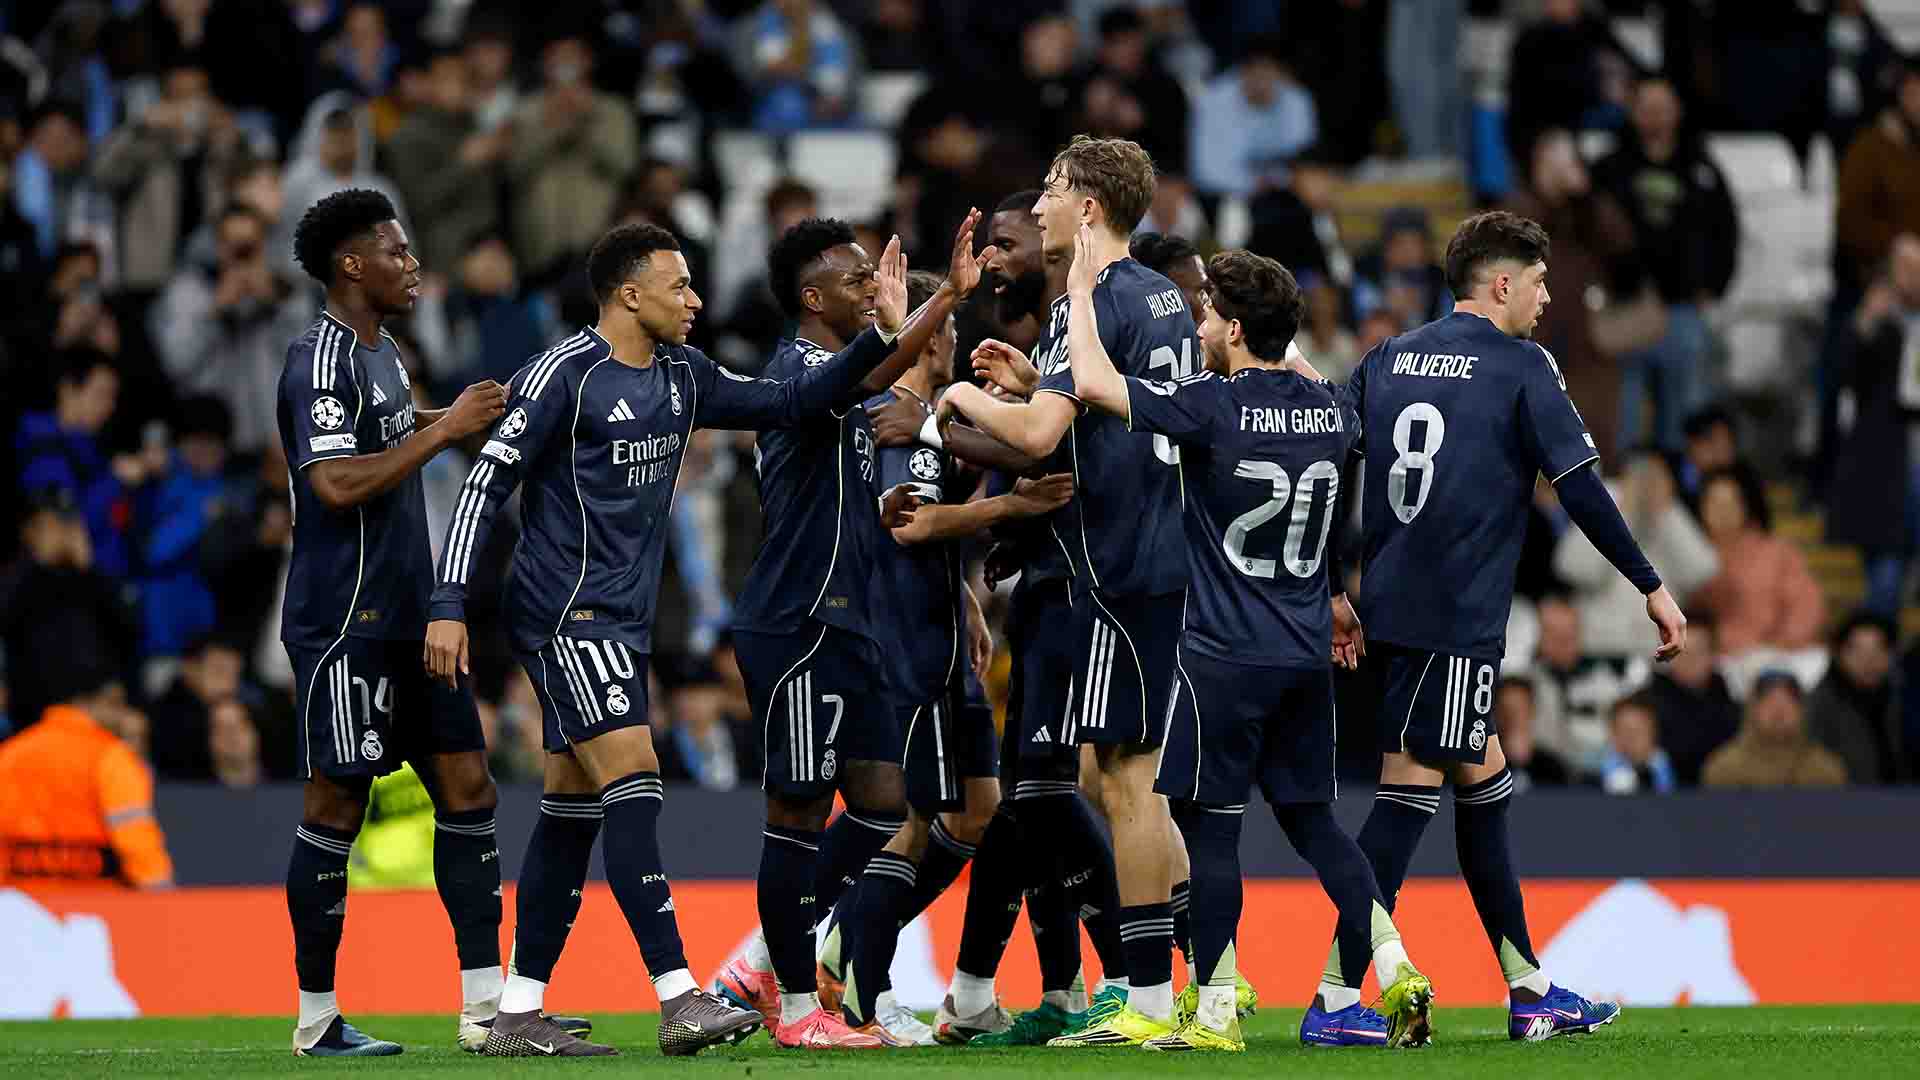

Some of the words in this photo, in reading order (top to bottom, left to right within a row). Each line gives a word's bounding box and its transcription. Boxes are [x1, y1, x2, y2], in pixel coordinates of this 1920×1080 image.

[1392, 352, 1479, 380] VALVERDE
[1240, 405, 1287, 434] FRAN
[612, 432, 681, 465] Emirates
[1387, 402, 1445, 525] 8
[627, 465, 647, 487] FLY
[1222, 459, 1340, 579] 20
[577, 639, 634, 684] 10
[352, 676, 395, 726] 14
[1473, 664, 1494, 715] 8
[822, 694, 844, 745] 7
